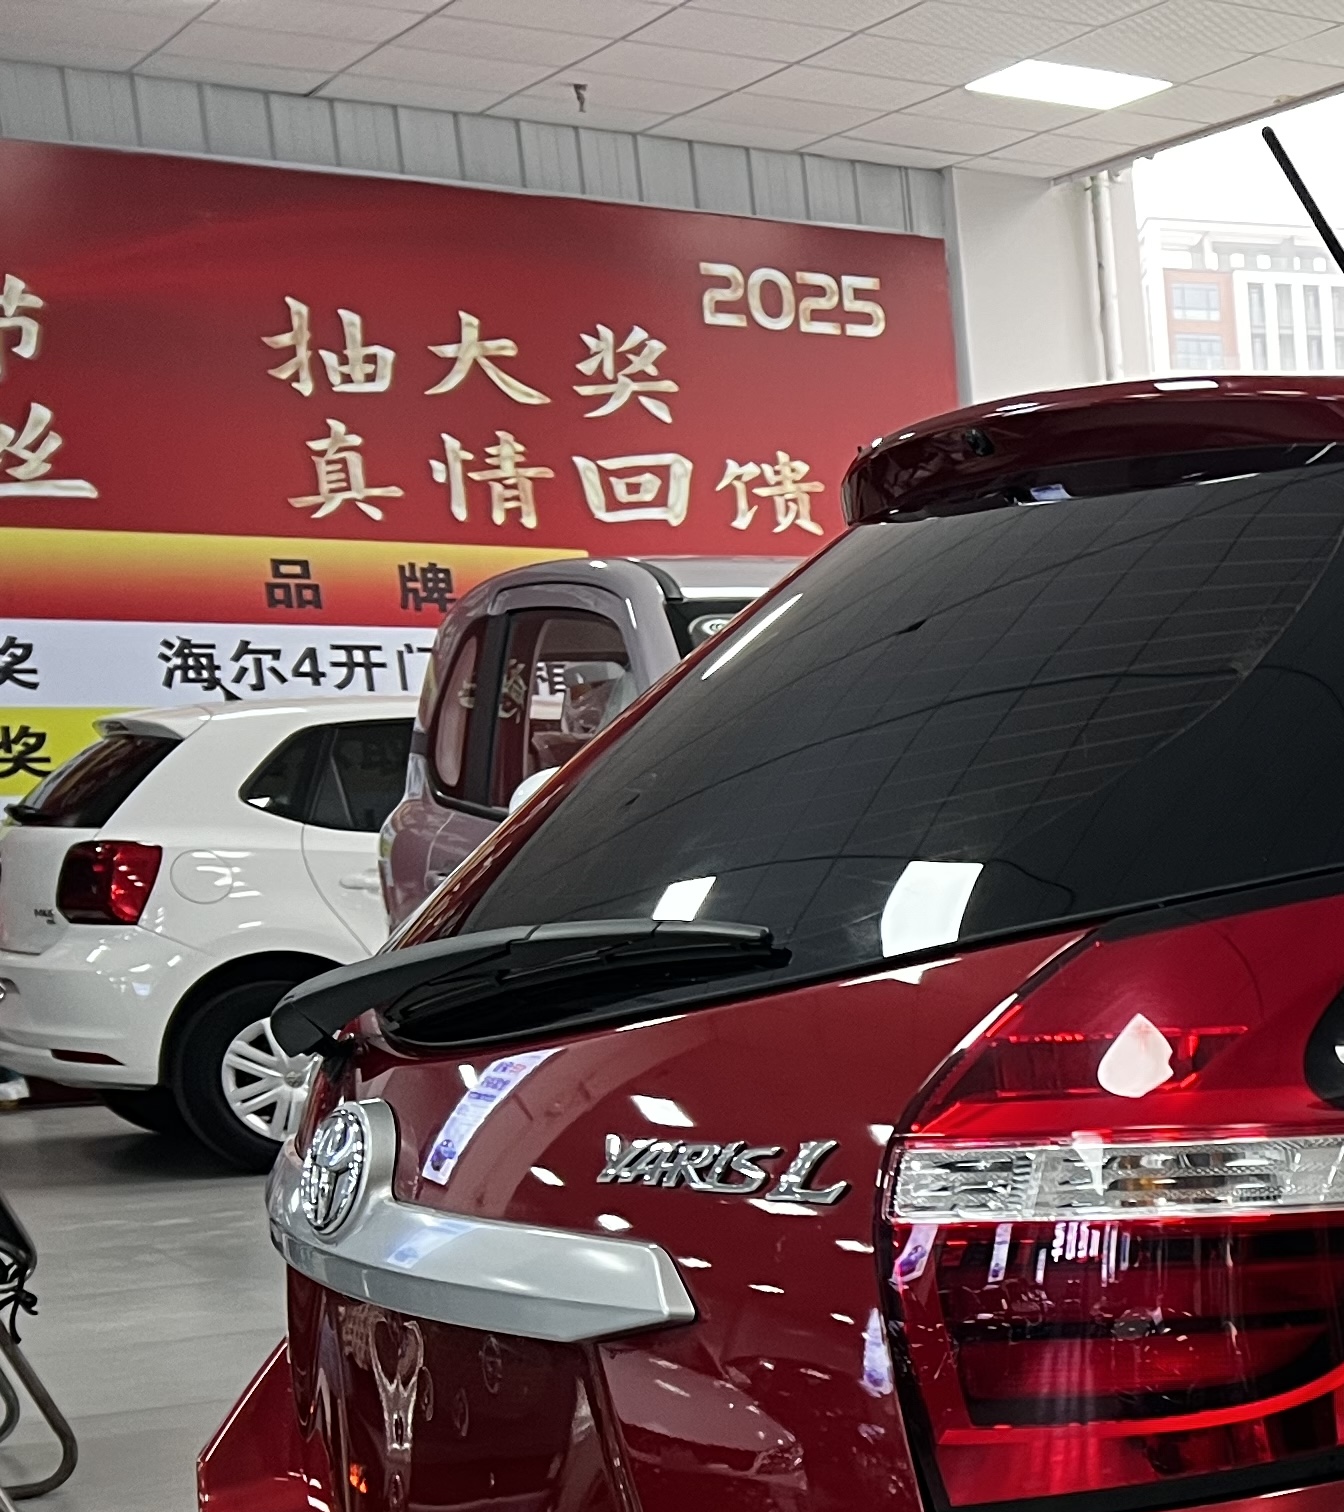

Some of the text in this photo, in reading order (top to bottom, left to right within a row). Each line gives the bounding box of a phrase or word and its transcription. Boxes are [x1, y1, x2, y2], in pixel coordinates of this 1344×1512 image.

[699, 262, 887, 338] 2025
[260, 295, 681, 425] 抽大奖
[287, 418, 826, 537] 真情回馈
[0, 724, 54, 778] 奖
[596, 1133, 848, 1204] YARIS L
